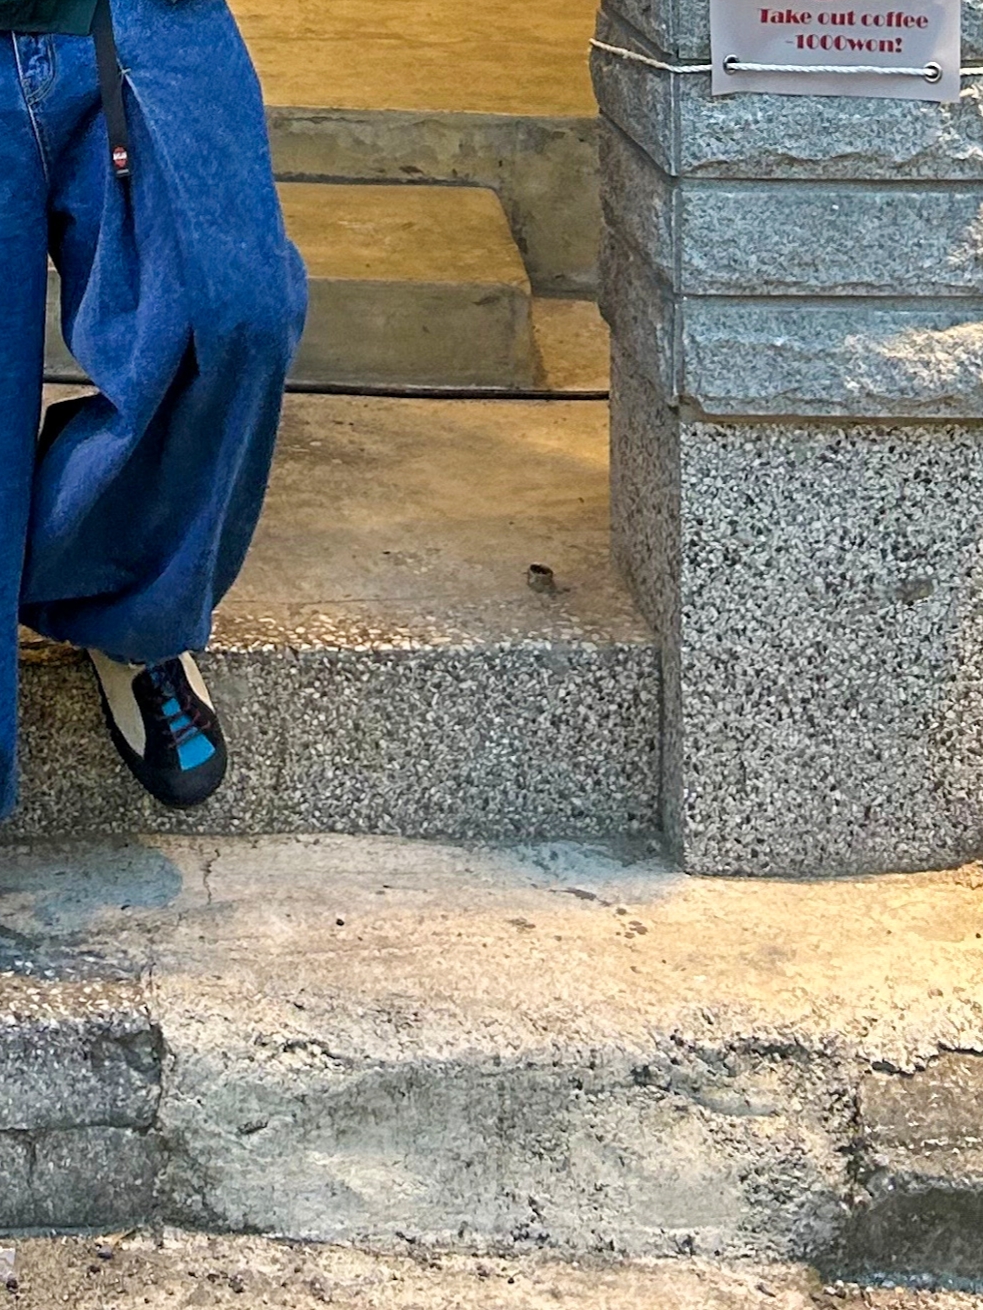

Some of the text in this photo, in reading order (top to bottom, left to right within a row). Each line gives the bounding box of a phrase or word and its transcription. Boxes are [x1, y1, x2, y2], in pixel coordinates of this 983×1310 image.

[759, 7, 929, 28] Take out coffee
